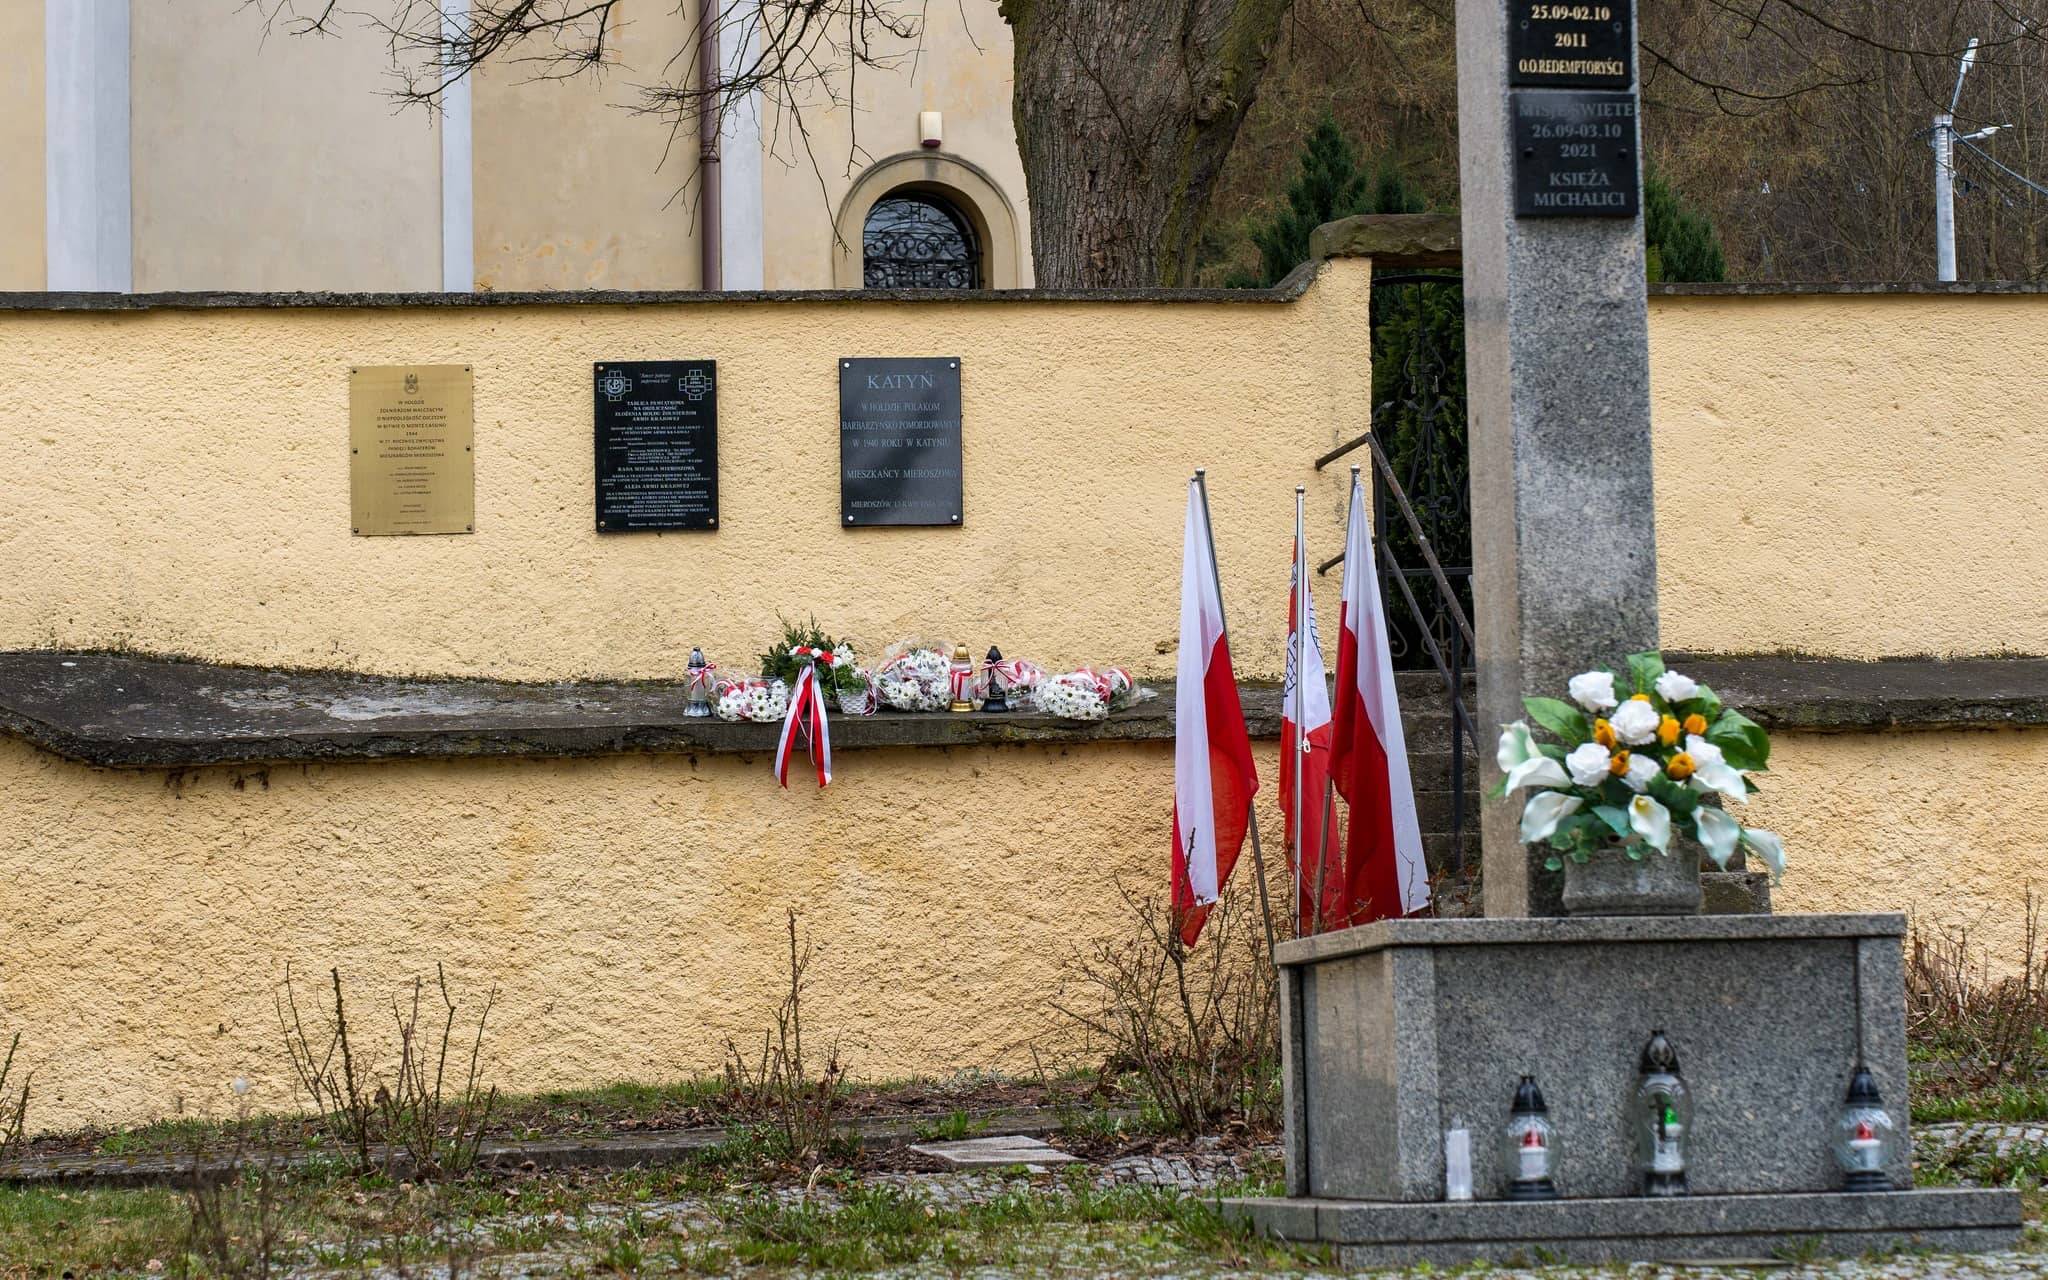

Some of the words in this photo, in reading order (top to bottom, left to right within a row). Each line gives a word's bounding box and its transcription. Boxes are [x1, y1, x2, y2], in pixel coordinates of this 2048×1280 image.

[1531, 5, 1611, 21] 25.09-02.10
[1554, 33, 1588, 48] 2011
[1518, 57, 1624, 76] O.O.REDEMPTORYŚCI
[1532, 124, 1622, 138] 26.09-03.10
[1560, 144, 1597, 158] 2021
[1549, 169, 1610, 189] KSIĘŻA
[1534, 192, 1626, 207] MICHALICI
[868, 371, 934, 389] KATYŃ
[904, 402, 940, 412] POLAKOM
[852, 440, 861, 448] W
[881, 438, 903, 448] ROKU
[906, 438, 914, 448] W
[847, 468, 900, 479] MIESZKAŃCY
